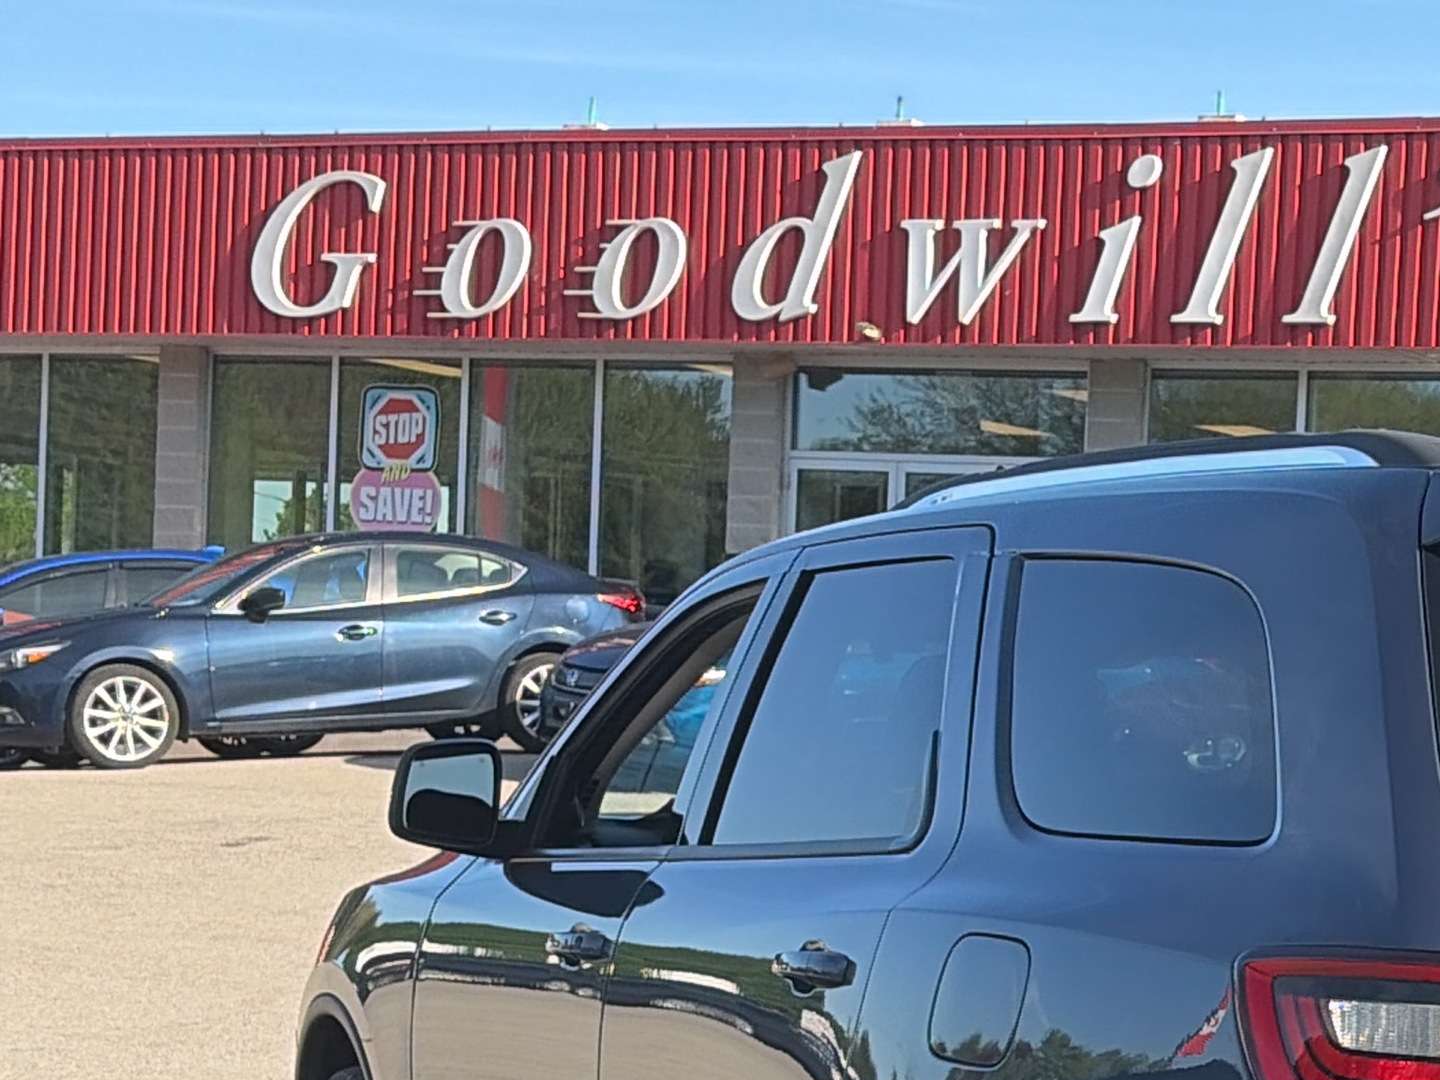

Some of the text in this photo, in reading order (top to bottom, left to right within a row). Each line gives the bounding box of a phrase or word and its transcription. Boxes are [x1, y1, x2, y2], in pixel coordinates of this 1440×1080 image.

[374, 412, 424, 445] STOP
[381, 463, 412, 483] AND
[358, 485, 434, 526] SAVE!
